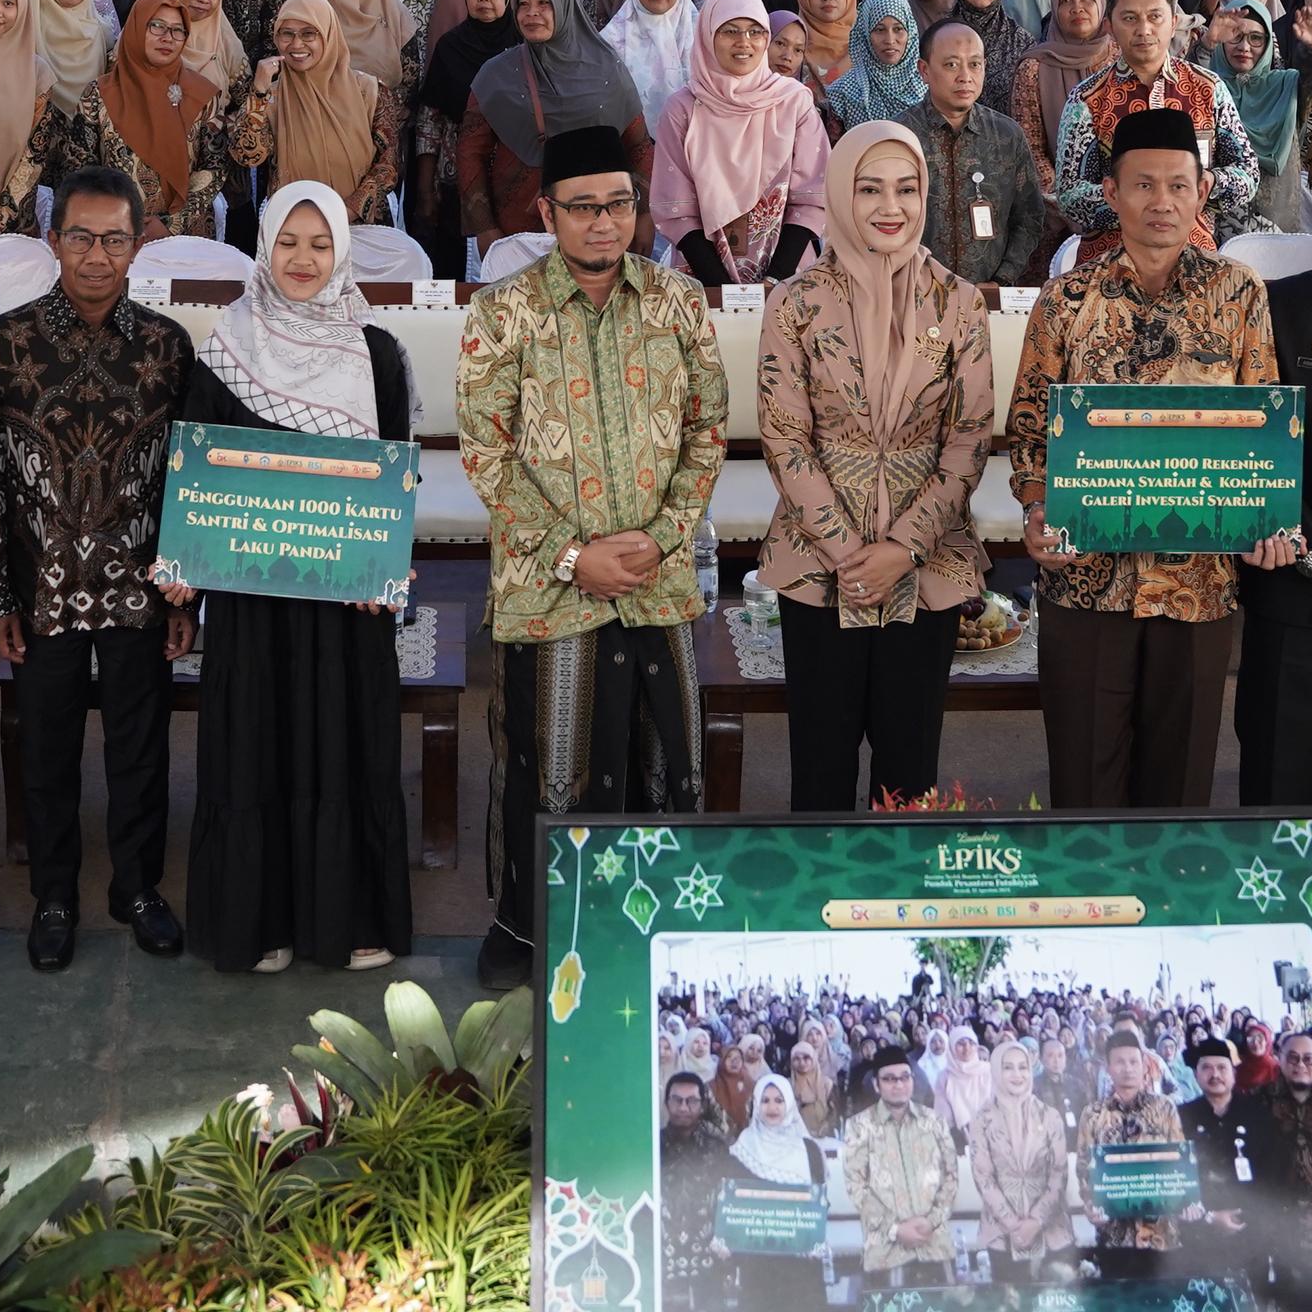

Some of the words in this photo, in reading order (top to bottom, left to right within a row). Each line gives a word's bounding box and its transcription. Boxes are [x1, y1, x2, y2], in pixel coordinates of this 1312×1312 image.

[1076, 455, 1161, 471] PEMBUKAAN
[1164, 458, 1199, 470] 1000
[1202, 455, 1275, 471] REKENING
[1053, 476, 1135, 489] REKSADANA
[1138, 475, 1196, 489] SYARIAH
[1199, 476, 1212, 489] &
[1219, 475, 1296, 489] KOMITMEN
[177, 485, 295, 512] PENGGUNAAN
[299, 500, 341, 516] 1000
[345, 498, 402, 521] KARTU
[1081, 492, 1132, 507] GALERI
[1136, 492, 1204, 507] INVESTASI
[1207, 492, 1266, 507] SYARIAH
[186, 511, 249, 530] SANTRI
[252, 517, 268, 532] &
[272, 519, 389, 543] OPTIMALISASI
[229, 538, 275, 556] LAKU
[279, 542, 342, 561] PANDAI
[937, 844, 1023, 875] EPIKS
[996, 906, 1016, 917] BSI
